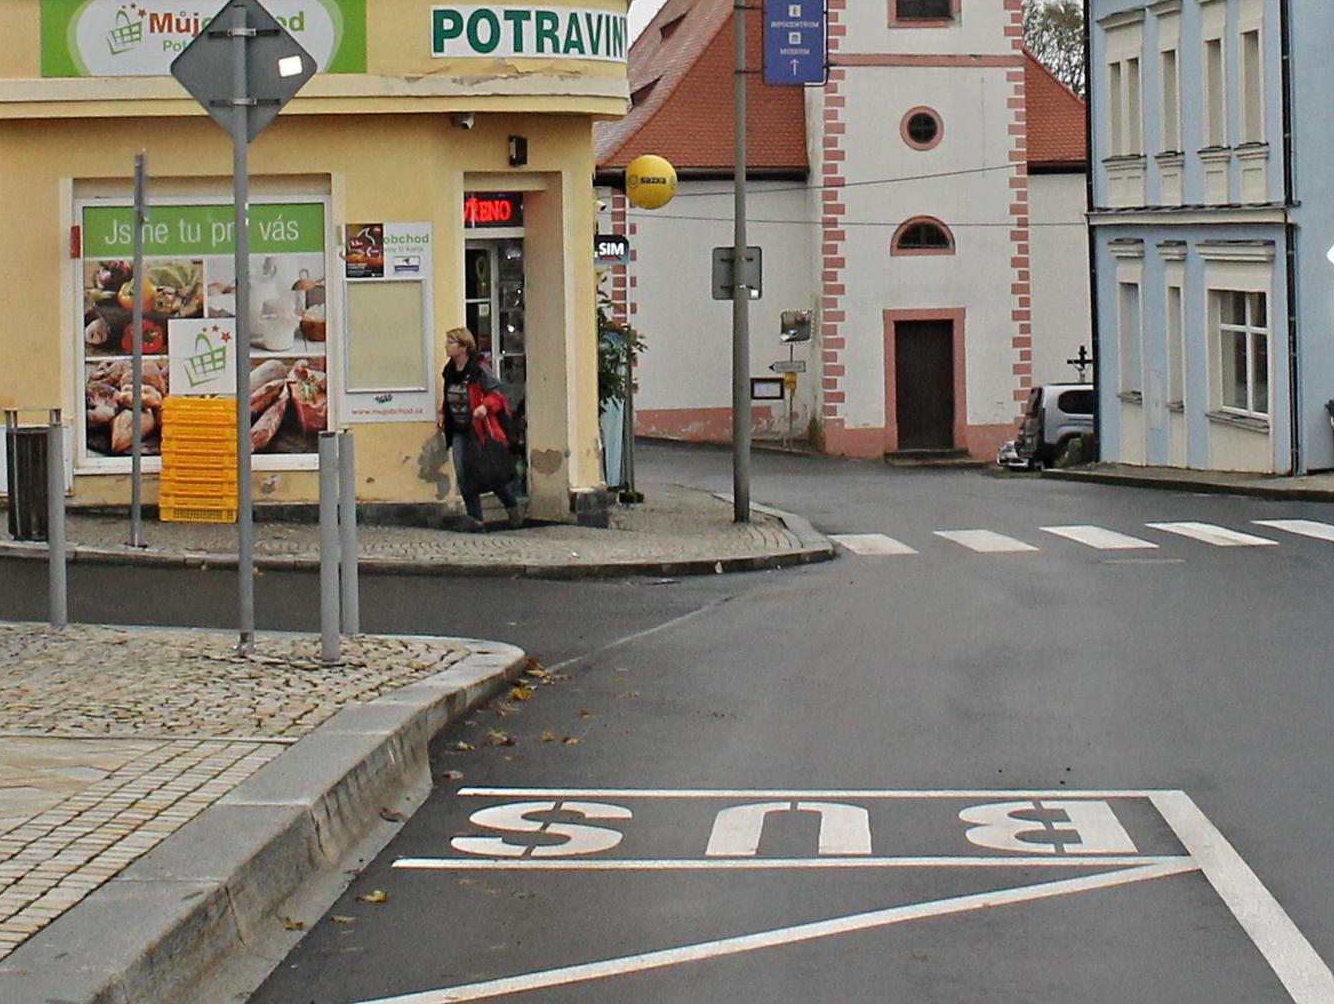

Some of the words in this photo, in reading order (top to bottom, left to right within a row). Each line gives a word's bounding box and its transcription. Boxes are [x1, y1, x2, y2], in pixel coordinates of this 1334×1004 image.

[179, 217, 202, 243] tu
[259, 213, 299, 242] vás
[599, 242, 624, 256] SIM
[450, 800, 1139, 858] BUS
